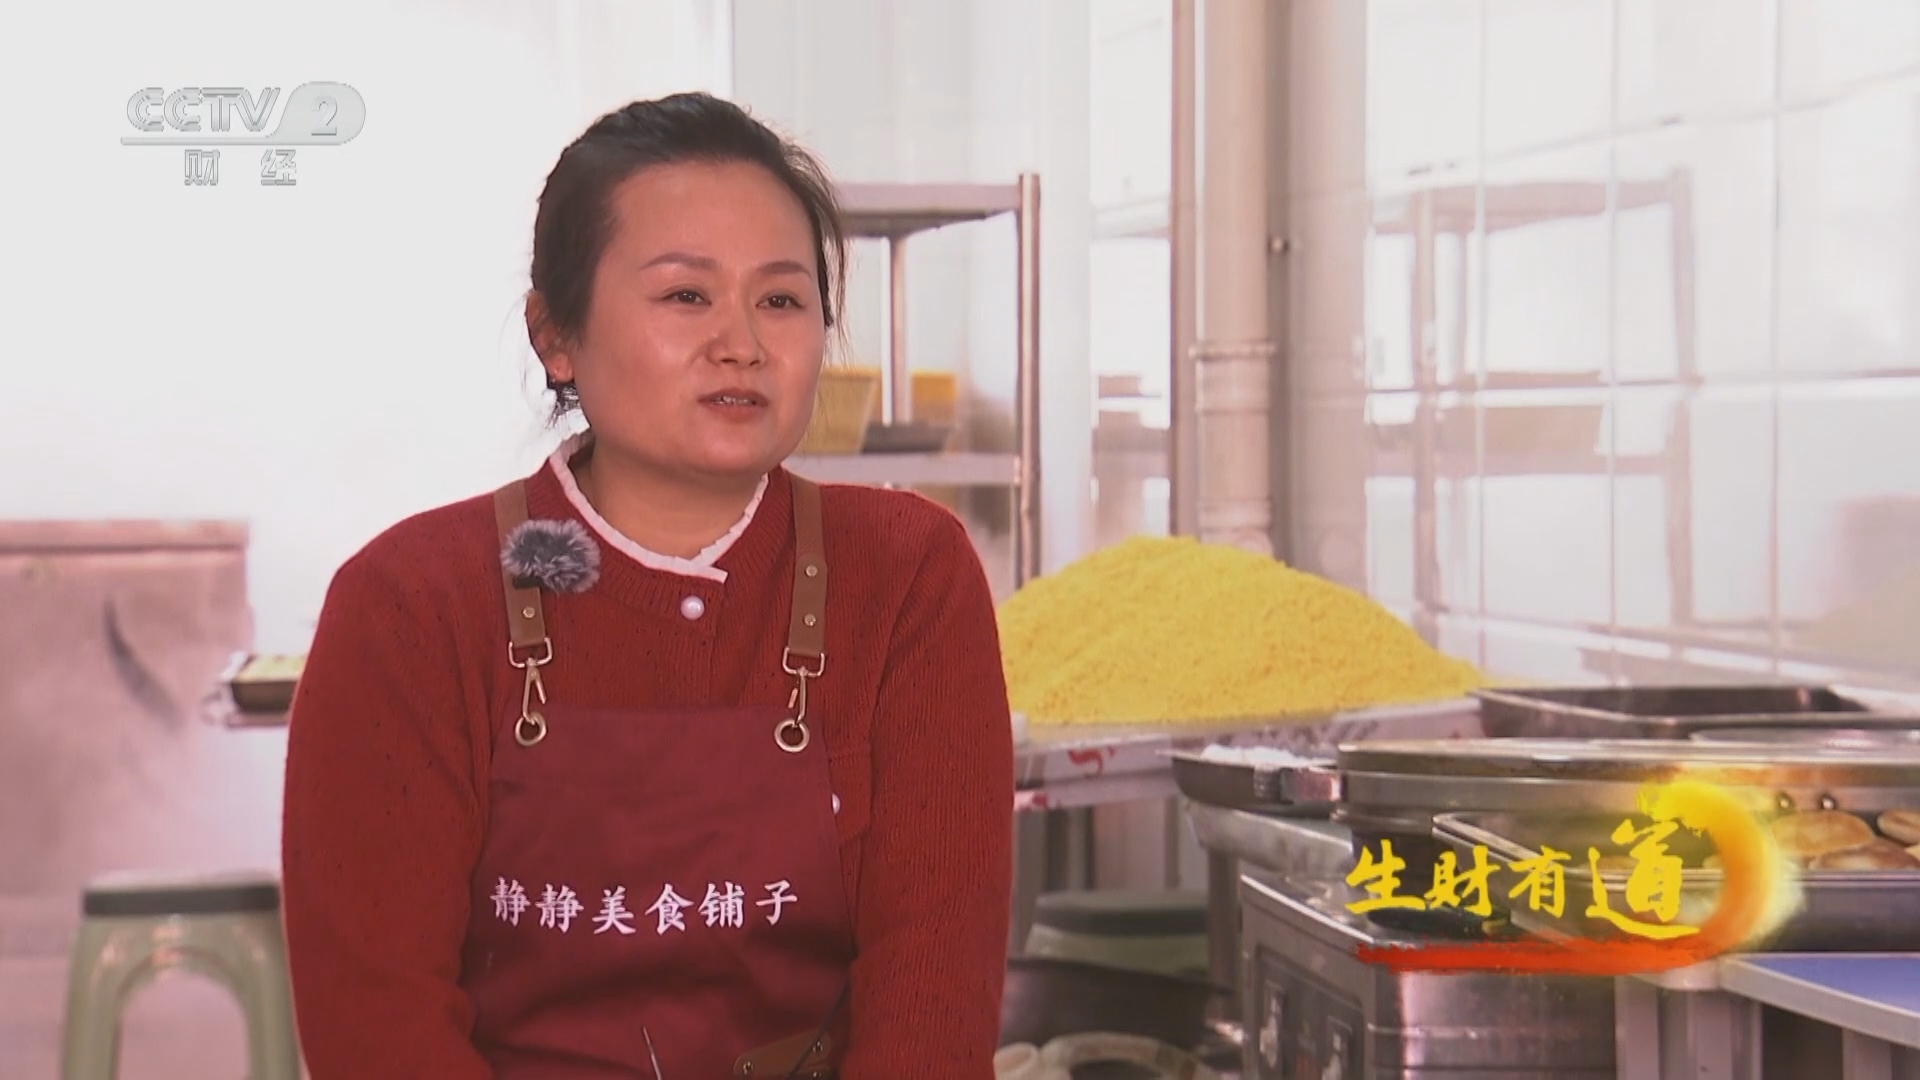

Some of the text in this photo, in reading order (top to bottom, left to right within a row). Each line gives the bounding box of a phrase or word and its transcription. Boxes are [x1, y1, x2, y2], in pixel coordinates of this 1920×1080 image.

[490, 876, 798, 935] 静静美食铺子
